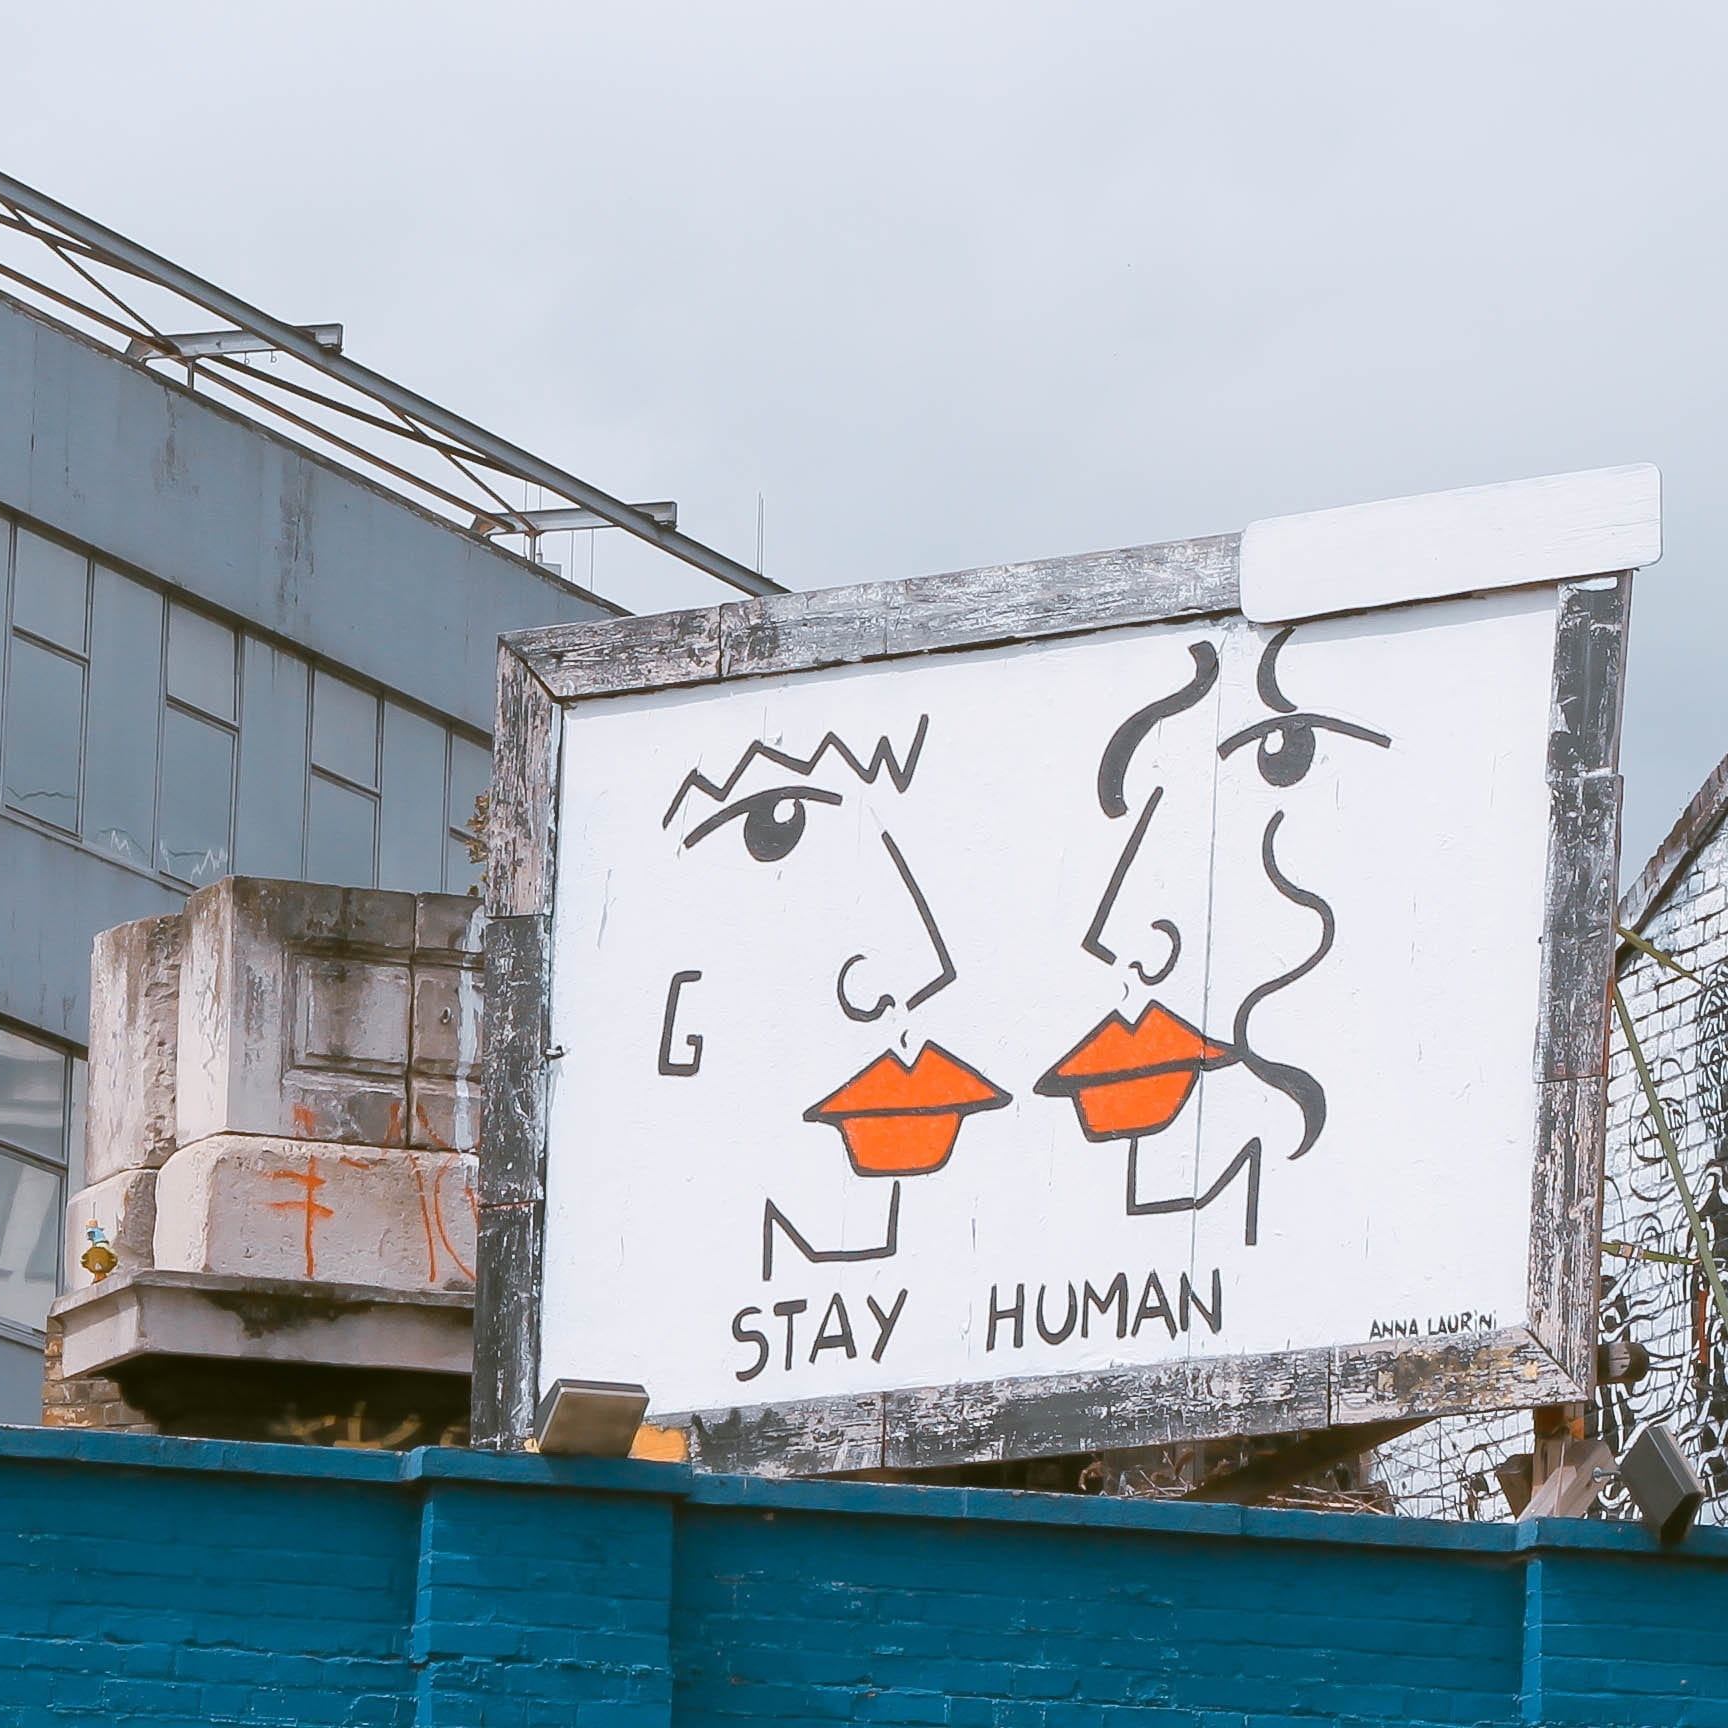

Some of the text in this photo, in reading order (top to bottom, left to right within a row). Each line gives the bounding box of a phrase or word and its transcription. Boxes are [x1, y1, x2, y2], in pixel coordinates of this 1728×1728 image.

[732, 1268, 1223, 1382] STAY HUMAN
[1369, 1318, 1419, 1340] ANNA
